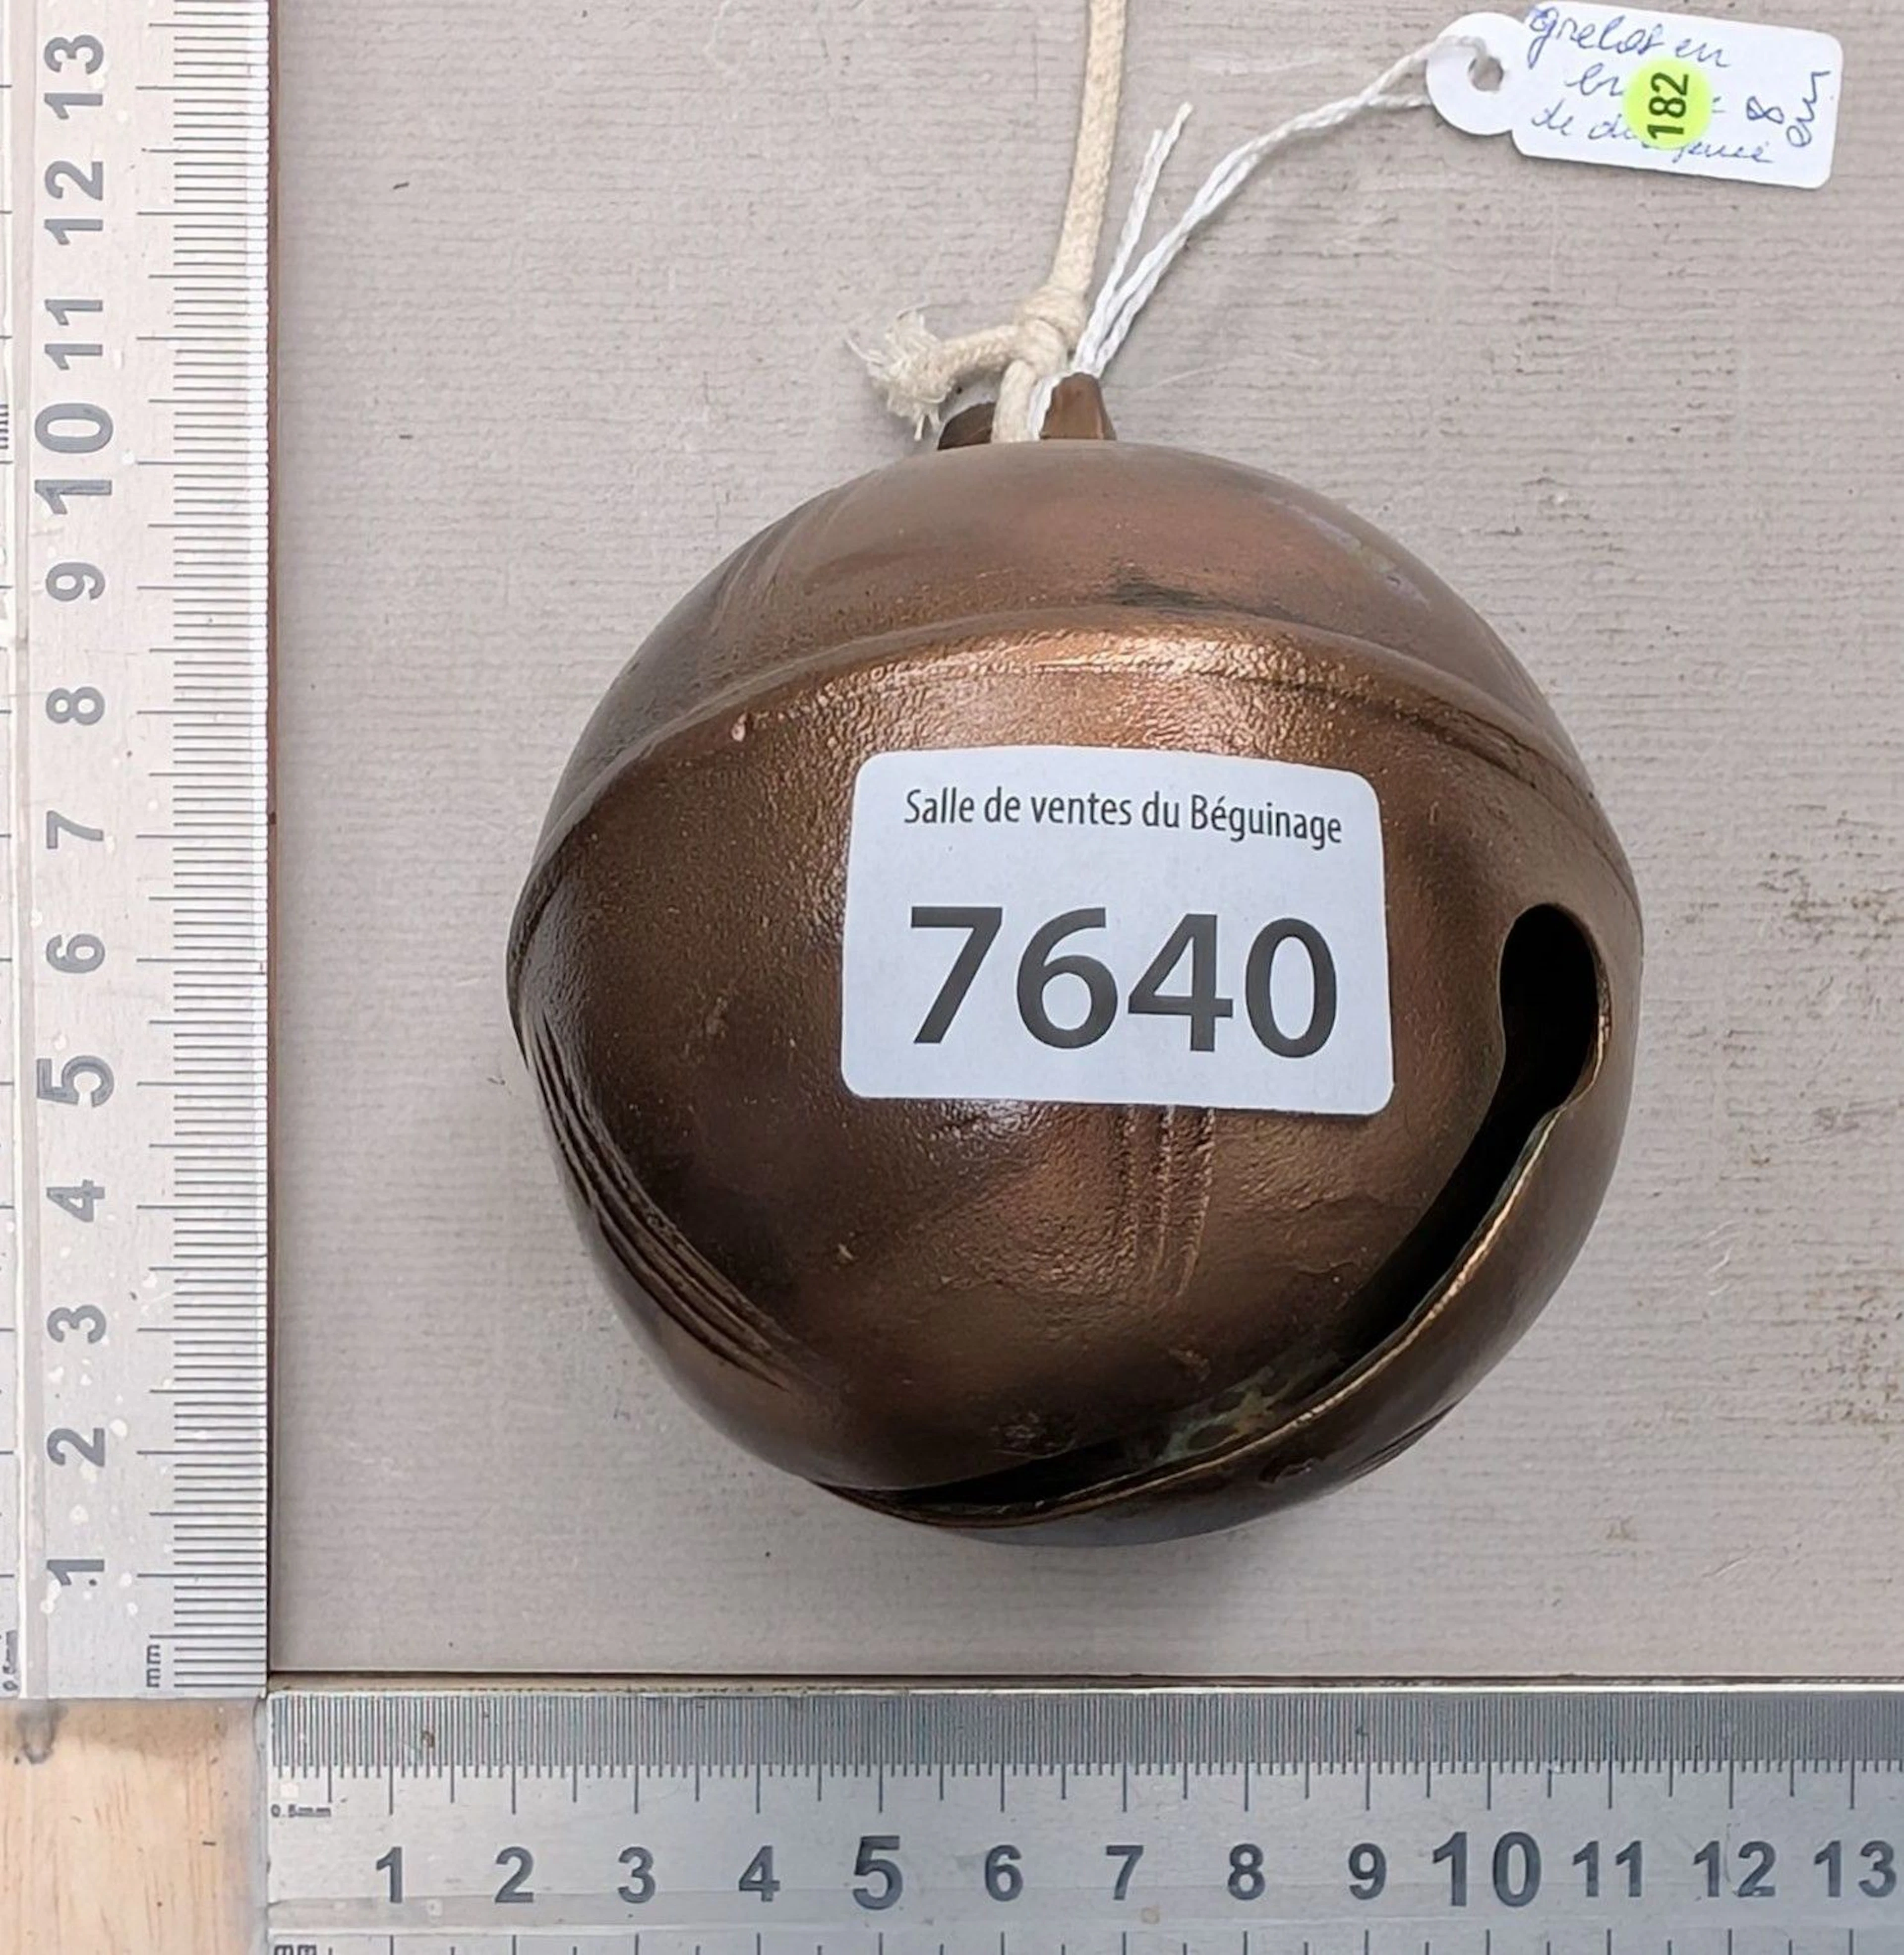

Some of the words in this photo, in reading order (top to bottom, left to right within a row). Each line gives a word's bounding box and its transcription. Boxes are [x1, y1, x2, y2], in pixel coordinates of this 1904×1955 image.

[1675, 38, 1731, 67] en
[44, 35, 104, 119] 13
[1647, 73, 1688, 139] 182
[44, 161, 103, 245] 12
[45, 299, 103, 370] 11
[34, 404, 113, 515] 10
[46, 563, 105, 601] 9
[46, 687, 105, 725] 8
[46, 811, 104, 849] 7
[905, 787, 974, 823] Salle
[985, 786, 1020, 823] de
[1031, 793, 1131, 827] ventes
[1142, 791, 1179, 828] du
[1191, 795, 1341, 850] Béguinage
[46, 934, 105, 973] 6
[911, 906, 1337, 1058] 7640
[37, 1056, 114, 1107] 5
[46, 1180, 105, 1222] 4
[47, 1305, 106, 1344] 3
[47, 1428, 105, 1467] 2
[46, 1559, 105, 1586] 1
[146, 1645, 160, 1688] mm
[376, 1847, 402, 1903] 1
[494, 1847, 534, 1904] 2
[618, 1847, 655, 1903] 3
[739, 1846, 780, 1902] 4
[853, 1836, 902, 1910] 5
[985, 1845, 1022, 1901] 6
[1106, 1845, 1143, 1900] 7
[1228, 1844, 1265, 1900] 8
[1349, 1843, 1386, 1900] 9
[1433, 1832, 1541, 1907] 10
[1573, 1840, 1641, 1897] 11
[1694, 1841, 1775, 1897] 12
[1814, 1840, 1896, 1897] 13
